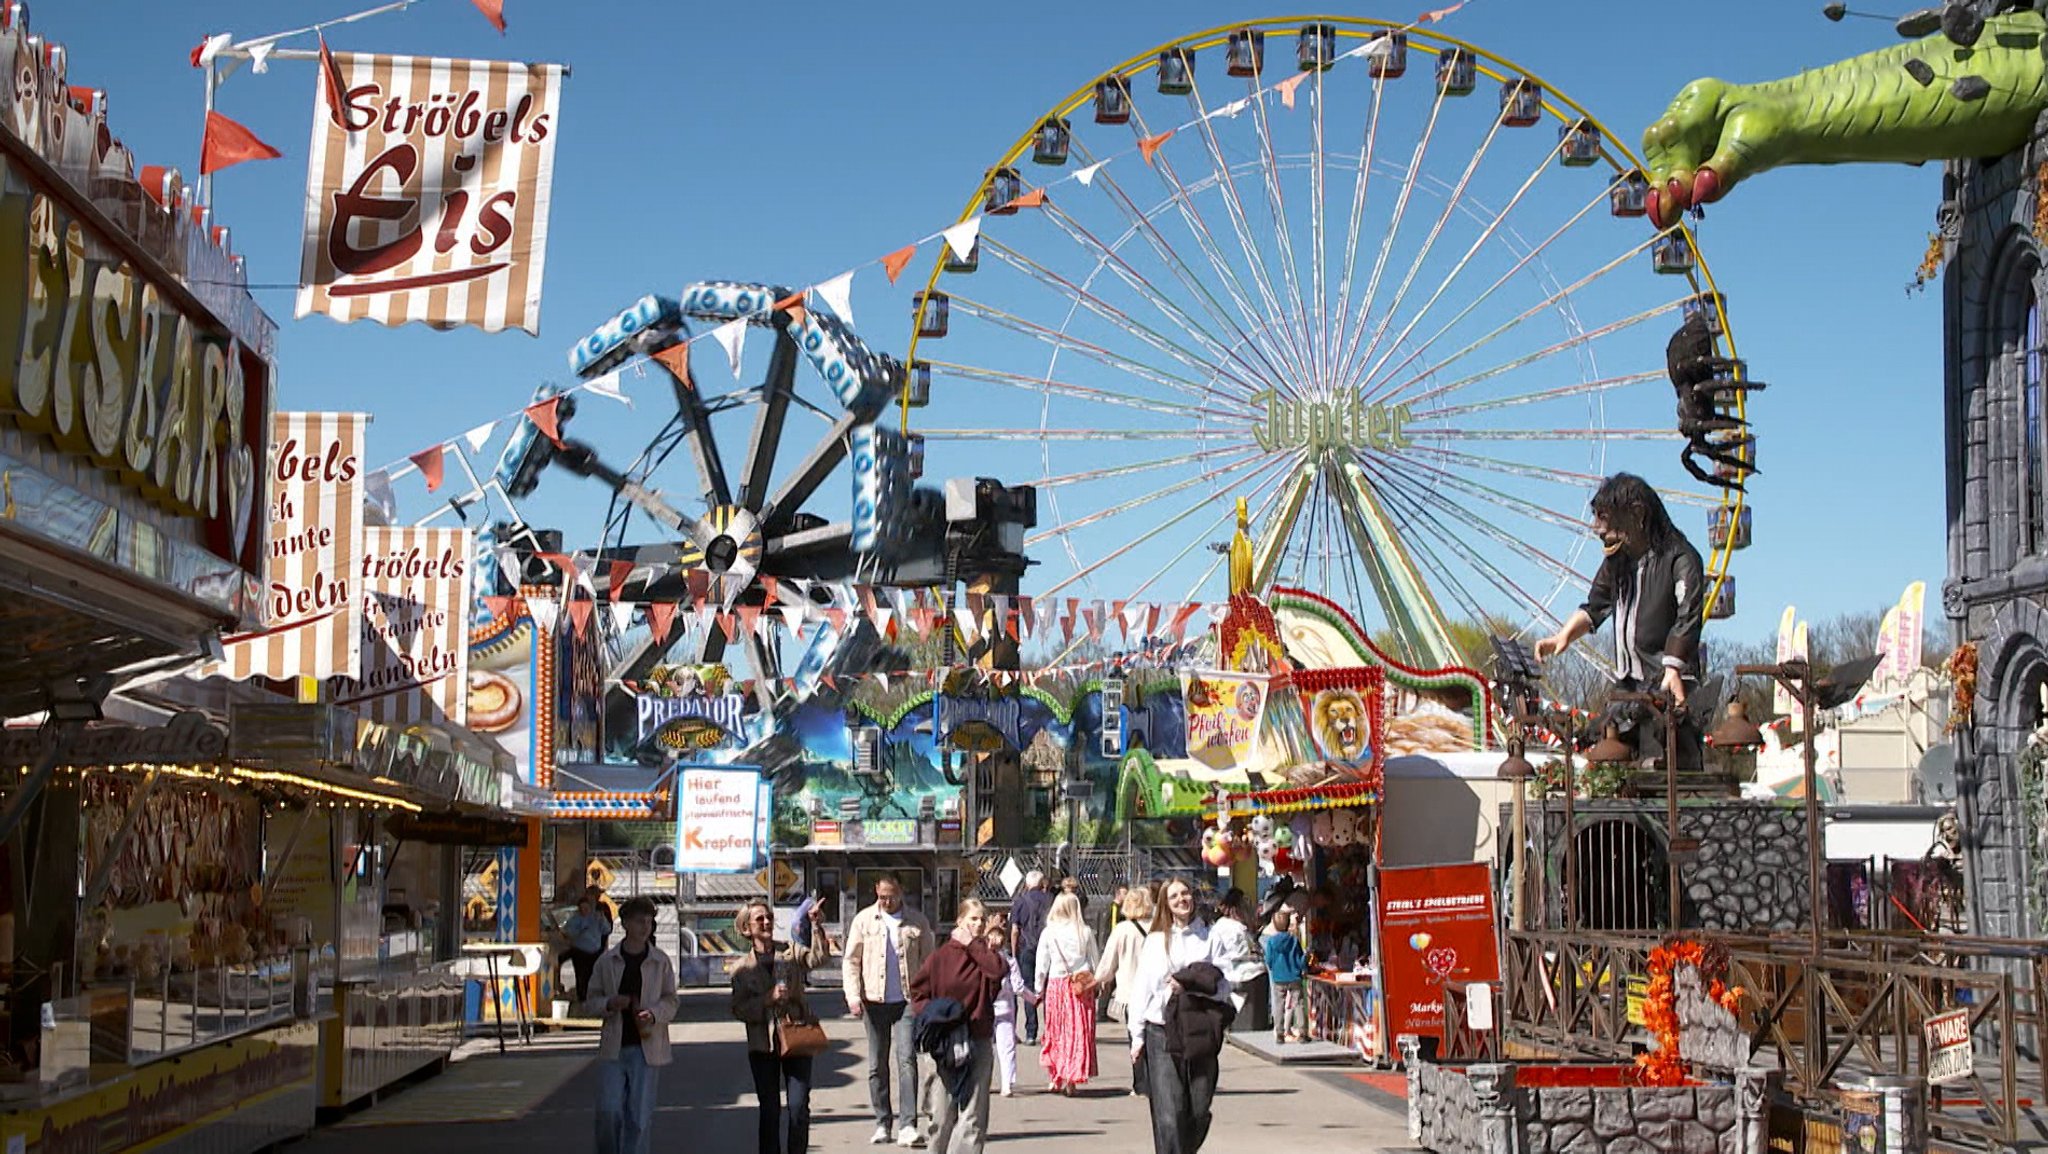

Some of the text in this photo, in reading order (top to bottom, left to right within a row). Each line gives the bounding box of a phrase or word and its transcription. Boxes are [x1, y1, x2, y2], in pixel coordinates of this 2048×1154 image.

[331, 83, 551, 145] Ströbels
[328, 144, 518, 275] Eis
[1250, 386, 1412, 463] Jupiter
[636, 693, 748, 744] PREDATOR
[688, 777, 722, 791] Hier
[695, 794, 741, 806] laufend
[685, 826, 751, 852] Krapfen
